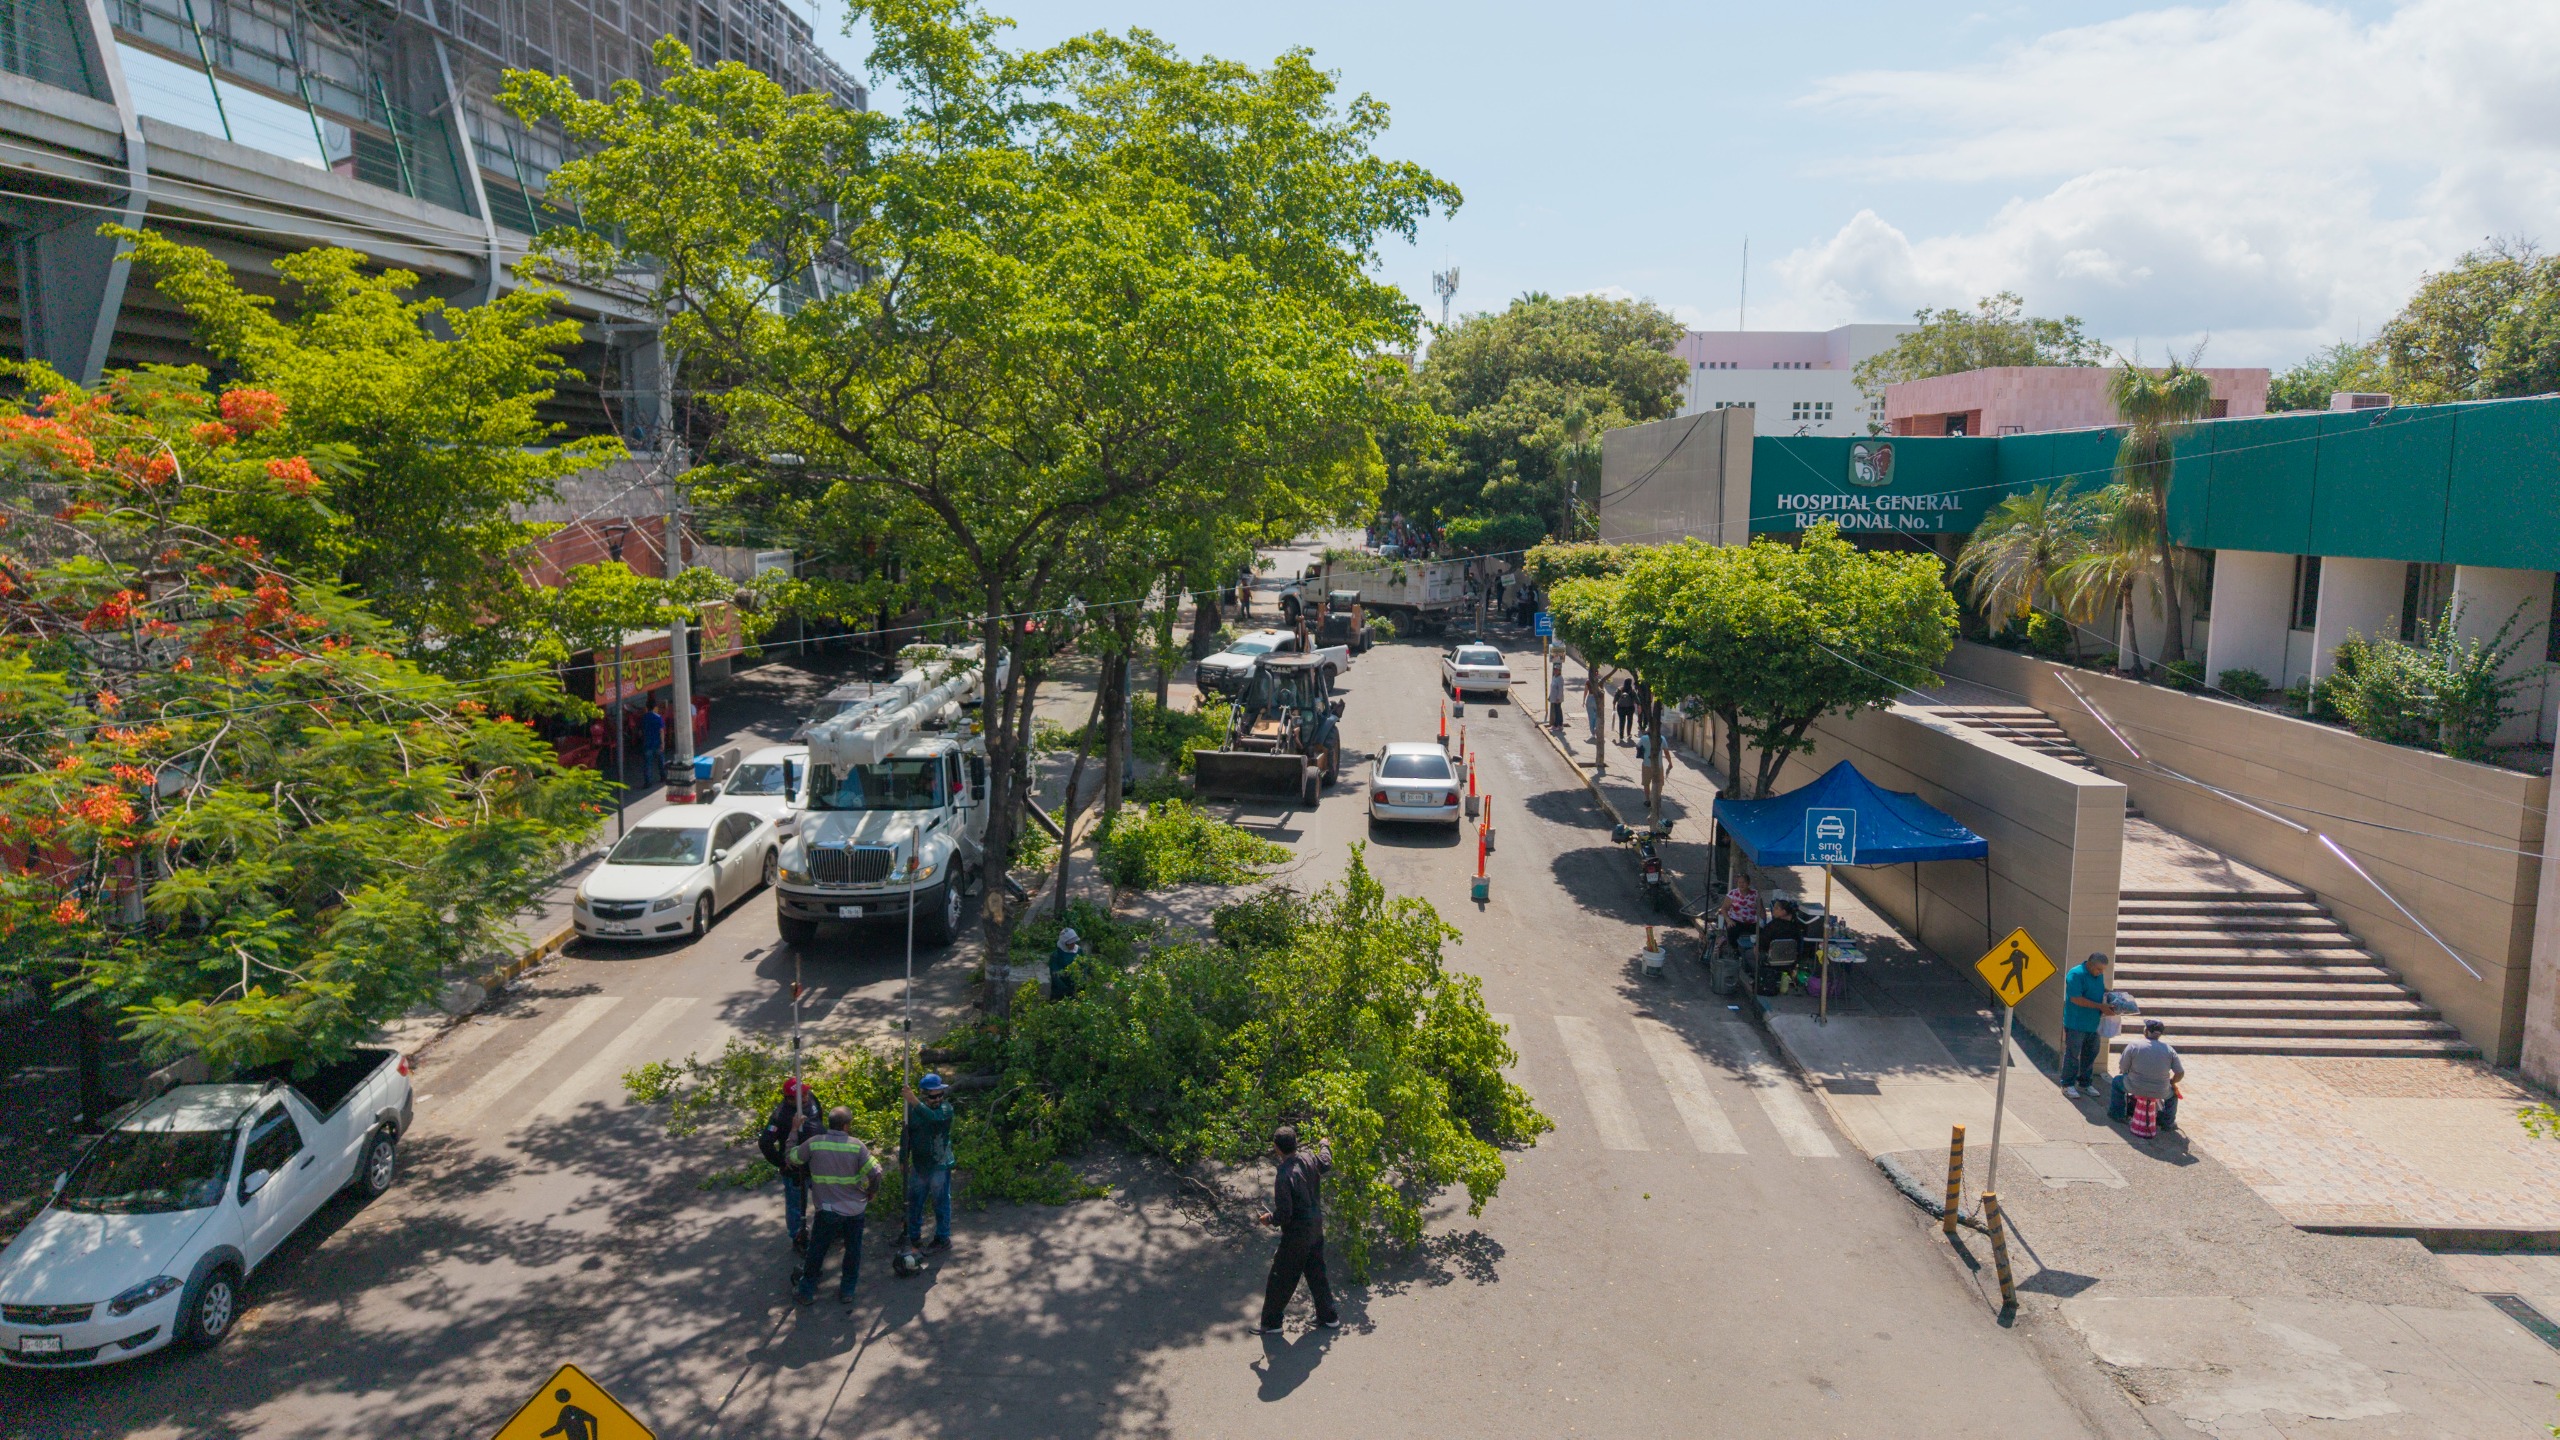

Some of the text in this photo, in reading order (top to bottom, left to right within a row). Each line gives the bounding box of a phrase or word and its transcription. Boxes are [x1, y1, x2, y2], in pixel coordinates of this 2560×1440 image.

[1777, 494, 1963, 510] HOSPITAL GENERAL
[1898, 513, 1930, 529] No.
[1935, 514, 1944, 529] 1
[1818, 842, 1842, 851] SITIO
[1820, 853, 1848, 862] SOCIAL
